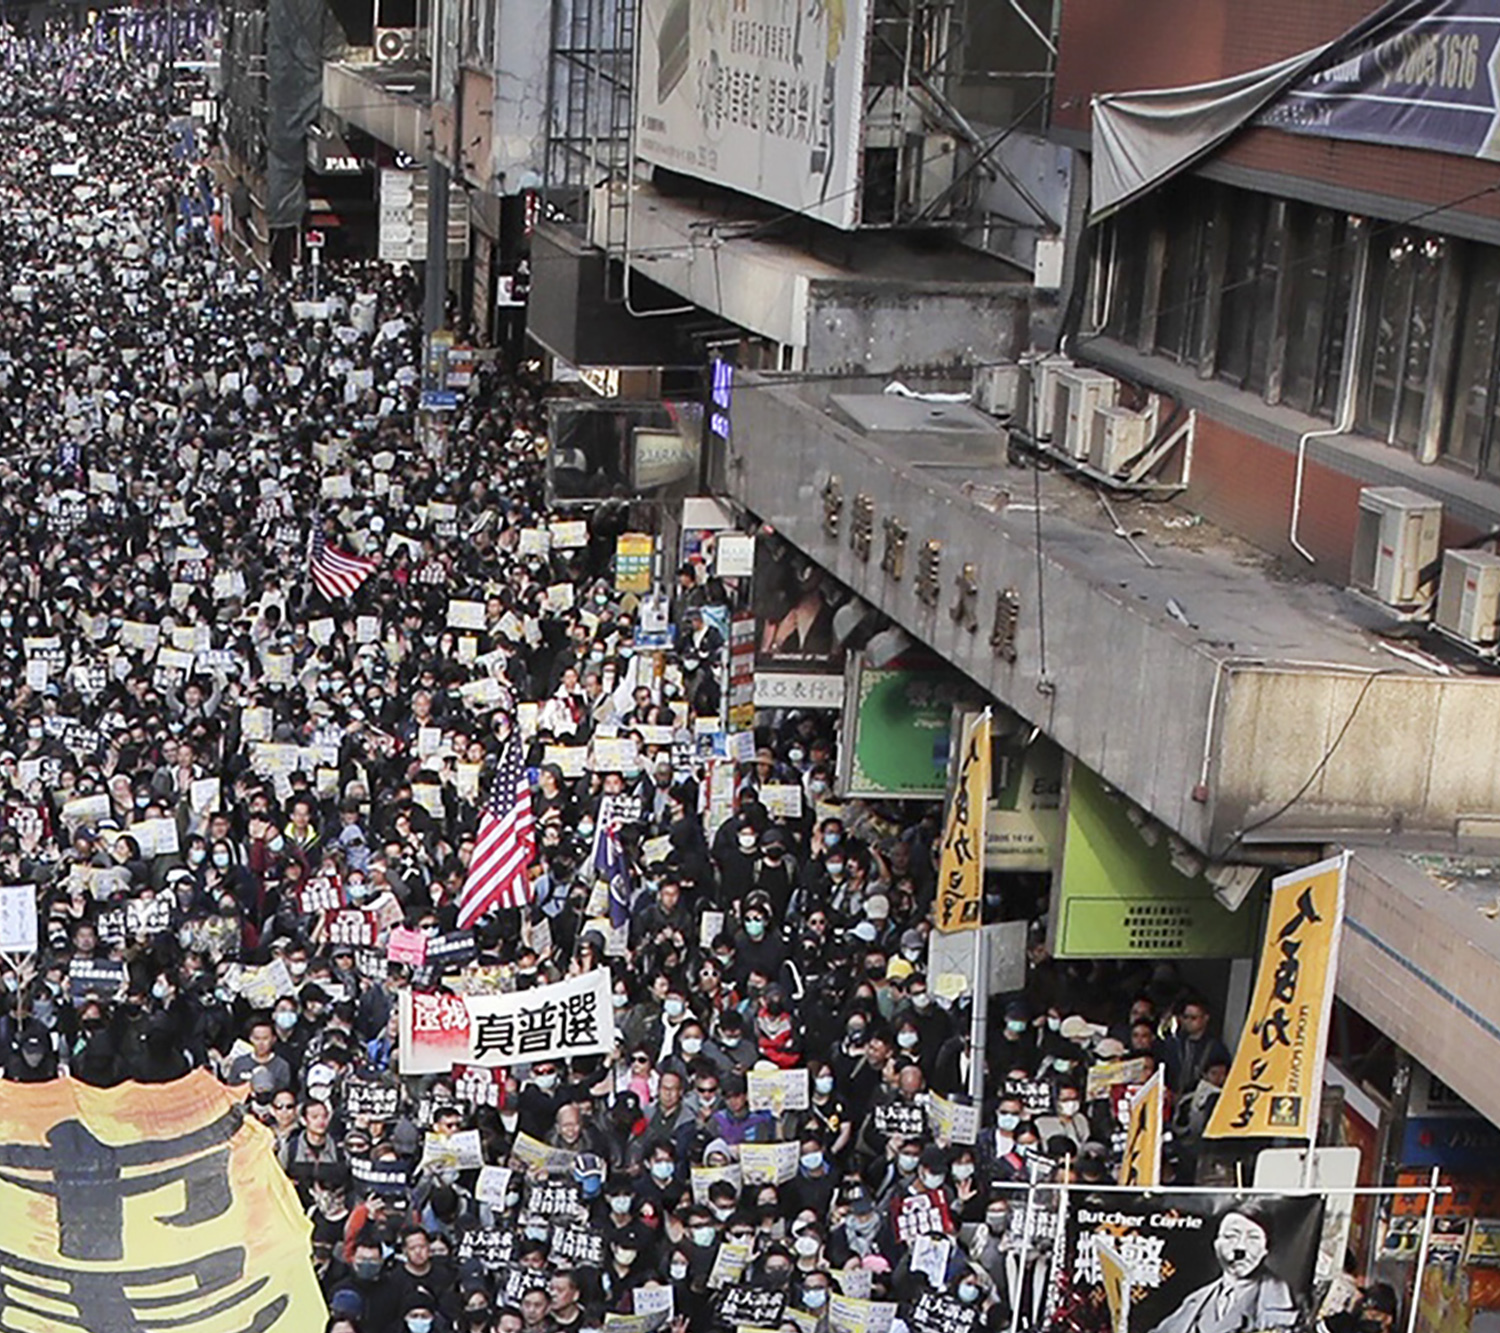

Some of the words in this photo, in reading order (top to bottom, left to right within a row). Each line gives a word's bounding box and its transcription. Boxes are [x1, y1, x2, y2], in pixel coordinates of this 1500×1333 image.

[412, 993, 470, 1032] 還我
[474, 990, 599, 1060] 真普選
[1078, 1209, 1146, 1228] Butcher
[1151, 1211, 1203, 1230] Carrie
